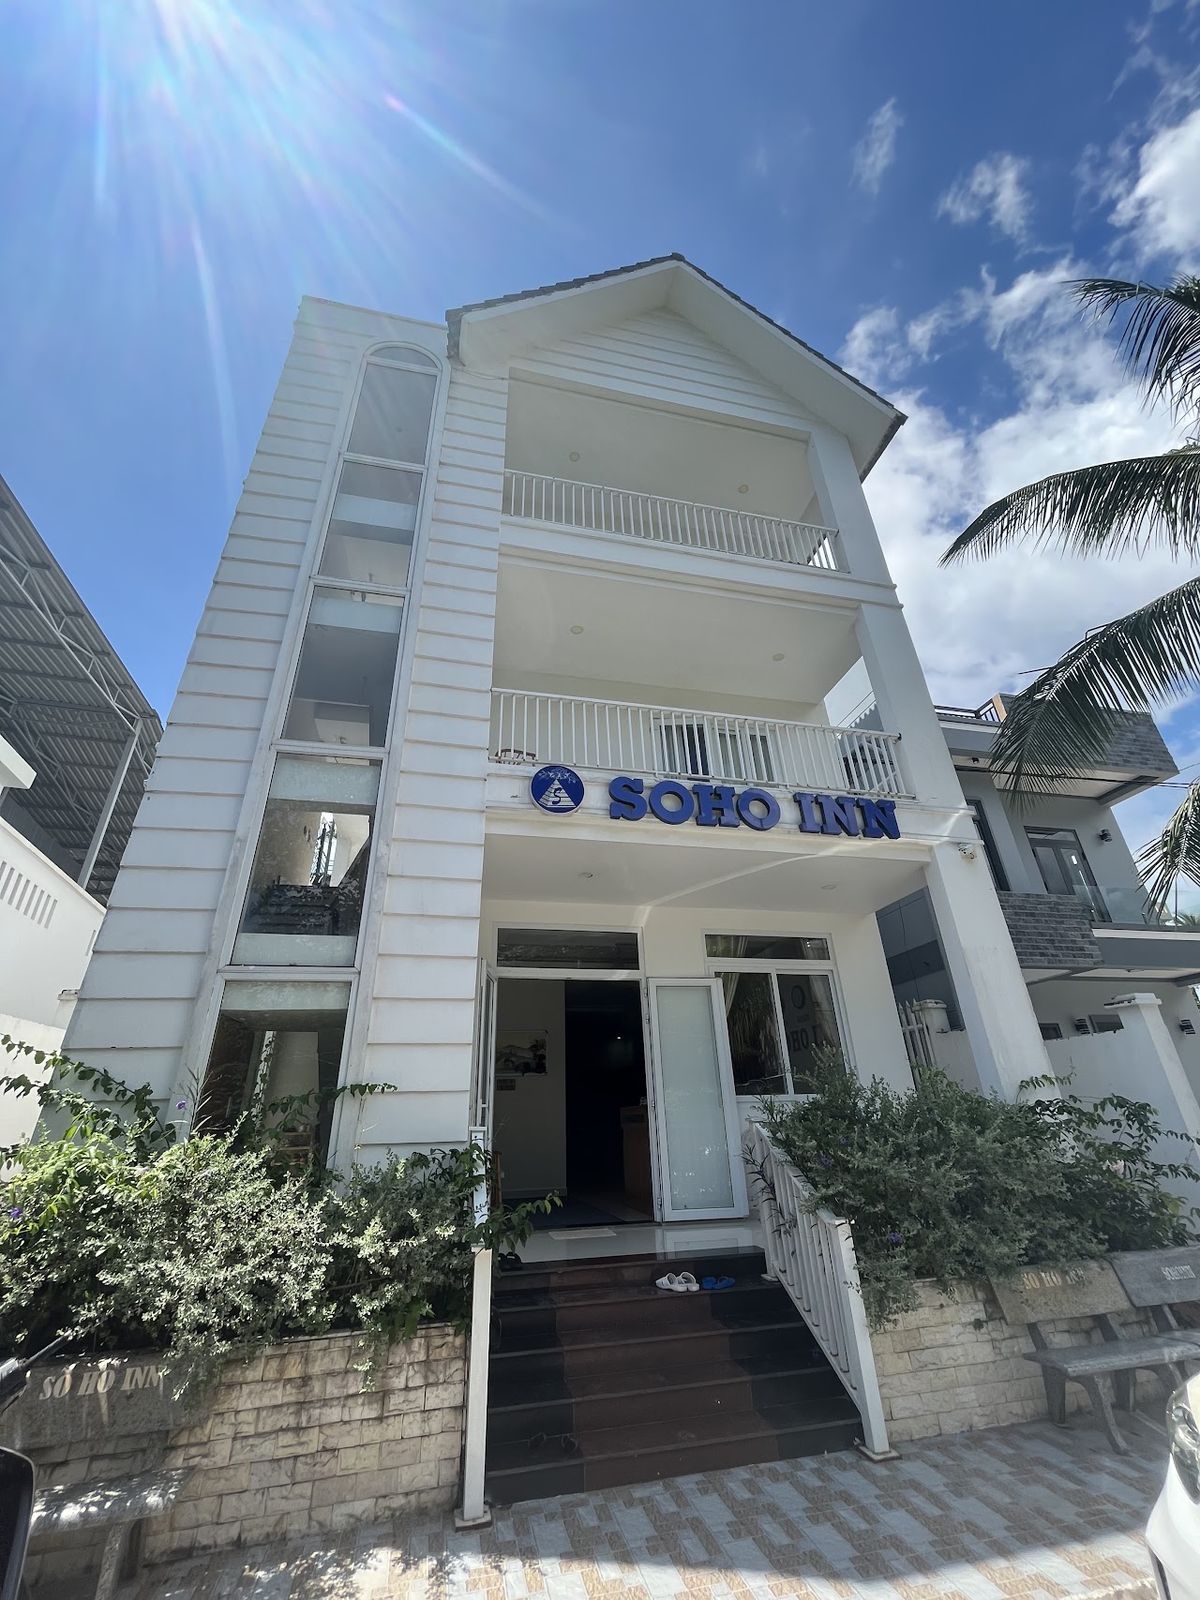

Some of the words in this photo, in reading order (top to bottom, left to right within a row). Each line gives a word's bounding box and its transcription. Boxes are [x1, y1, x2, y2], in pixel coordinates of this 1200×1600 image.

[609, 776, 781, 831] SOHO
[793, 792, 900, 839] INN
[39, 1374, 73, 1400] SO
[77, 1369, 116, 1395] HO
[120, 1365, 162, 1391] INN
